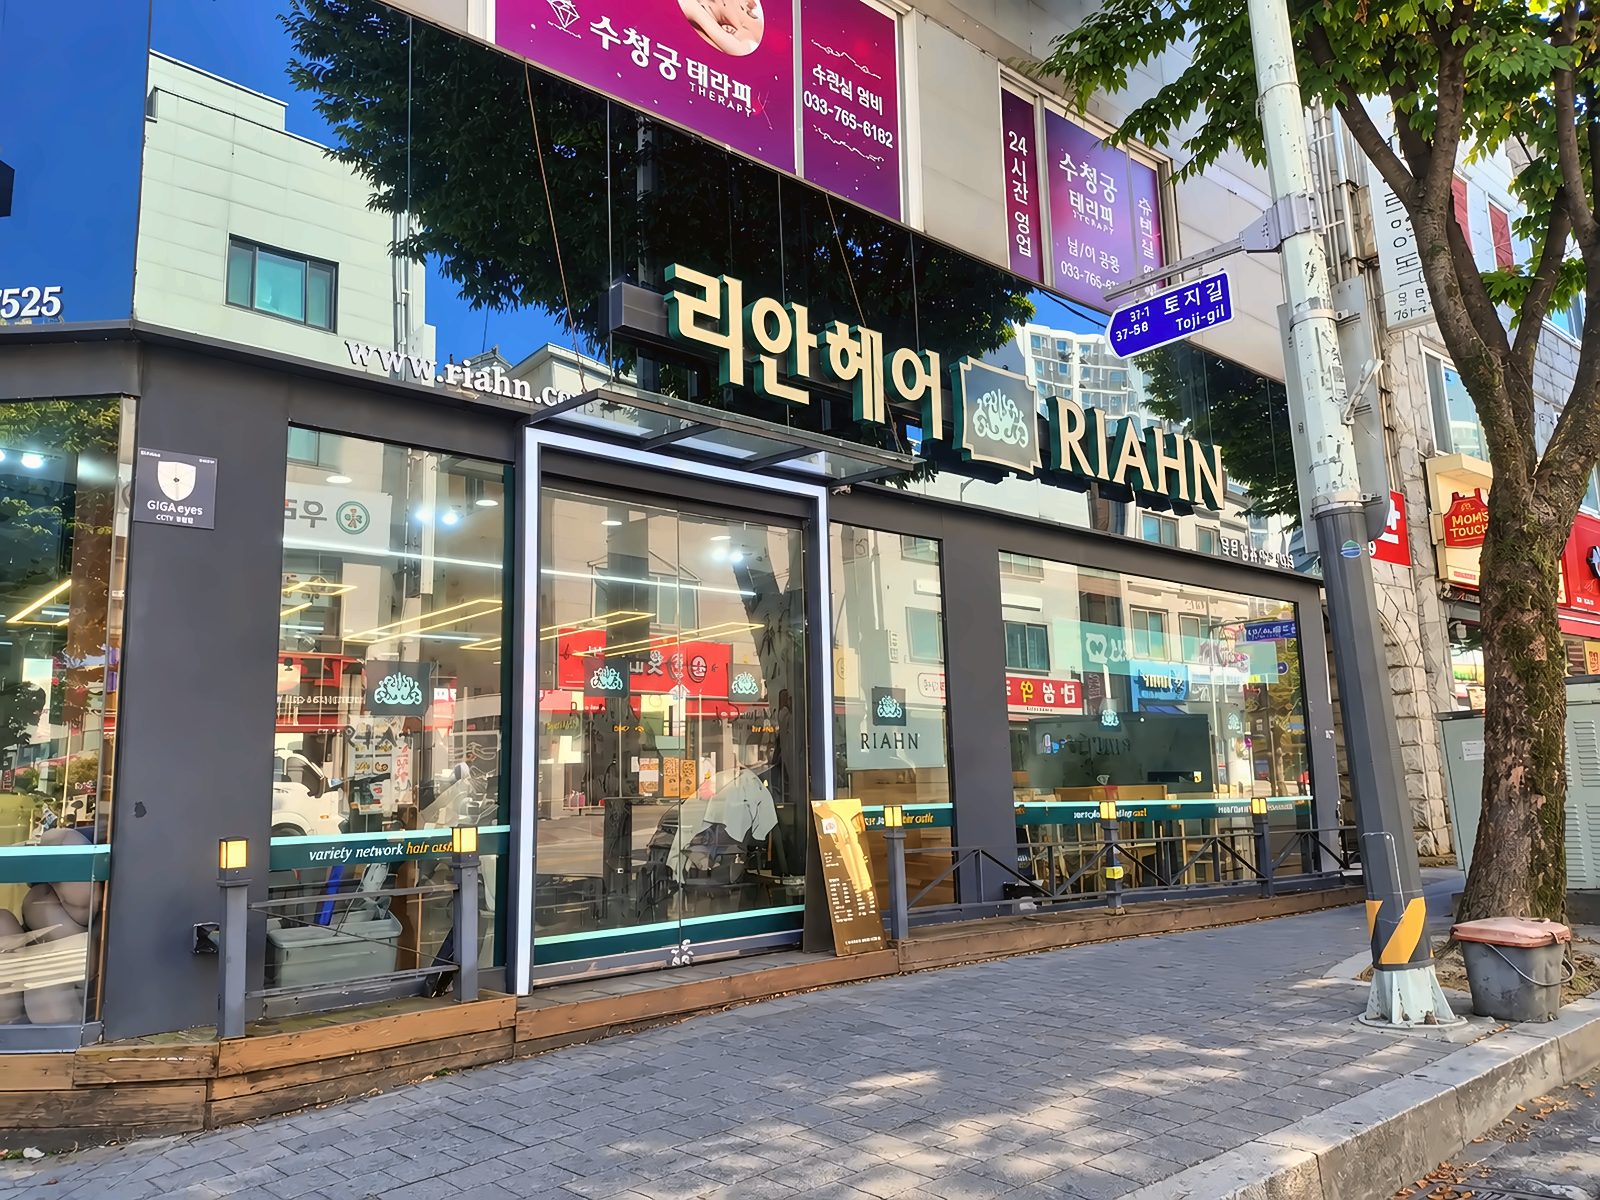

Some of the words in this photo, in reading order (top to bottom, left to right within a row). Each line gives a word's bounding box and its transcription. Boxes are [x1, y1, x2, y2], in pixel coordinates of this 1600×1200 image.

[590, 15, 682, 81] 수청궁
[689, 82, 755, 117] THERAPY
[803, 90, 893, 149] 033-765-6182
[1059, 152, 1118, 203] 수청궁
[1014, 211, 1032, 258] 영업
[0, 286, 62, 319] 525
[1163, 279, 1223, 316] 토지길
[1115, 321, 1149, 342] 37-58
[1175, 303, 1225, 331] Toji-gil
[664, 262, 943, 441] 리안헤어
[1046, 396, 1226, 511] RIAHN
[860, 732, 919, 750] RIAHN
[309, 846, 353, 863] variety
[355, 843, 404, 859] network
